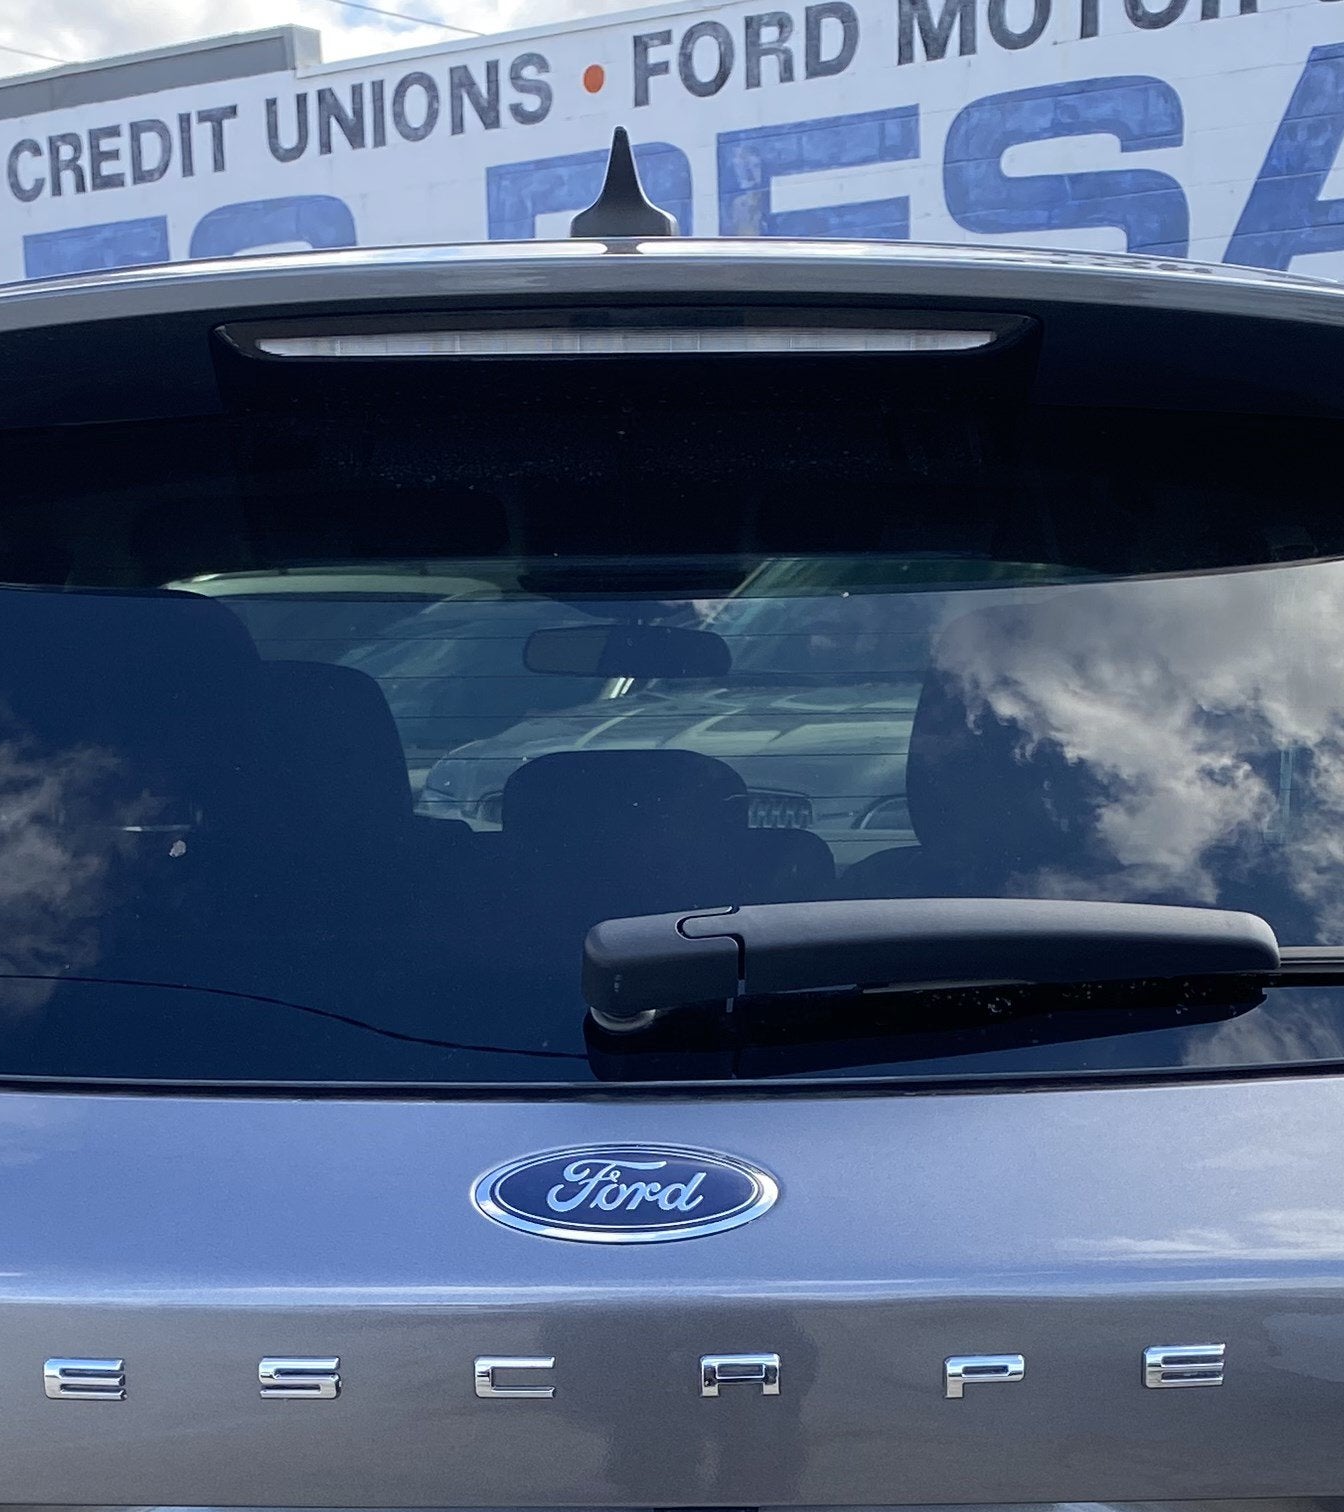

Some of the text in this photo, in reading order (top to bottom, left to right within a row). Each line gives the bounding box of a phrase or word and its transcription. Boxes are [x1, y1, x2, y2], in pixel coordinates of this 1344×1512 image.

[7, 104, 238, 202] CREDIT
[265, 52, 554, 162] UNIONS
[632, 1, 859, 108] FORD
[546, 1158, 707, 1213] Ford
[43, 1342, 1227, 1401] ESCAPE
